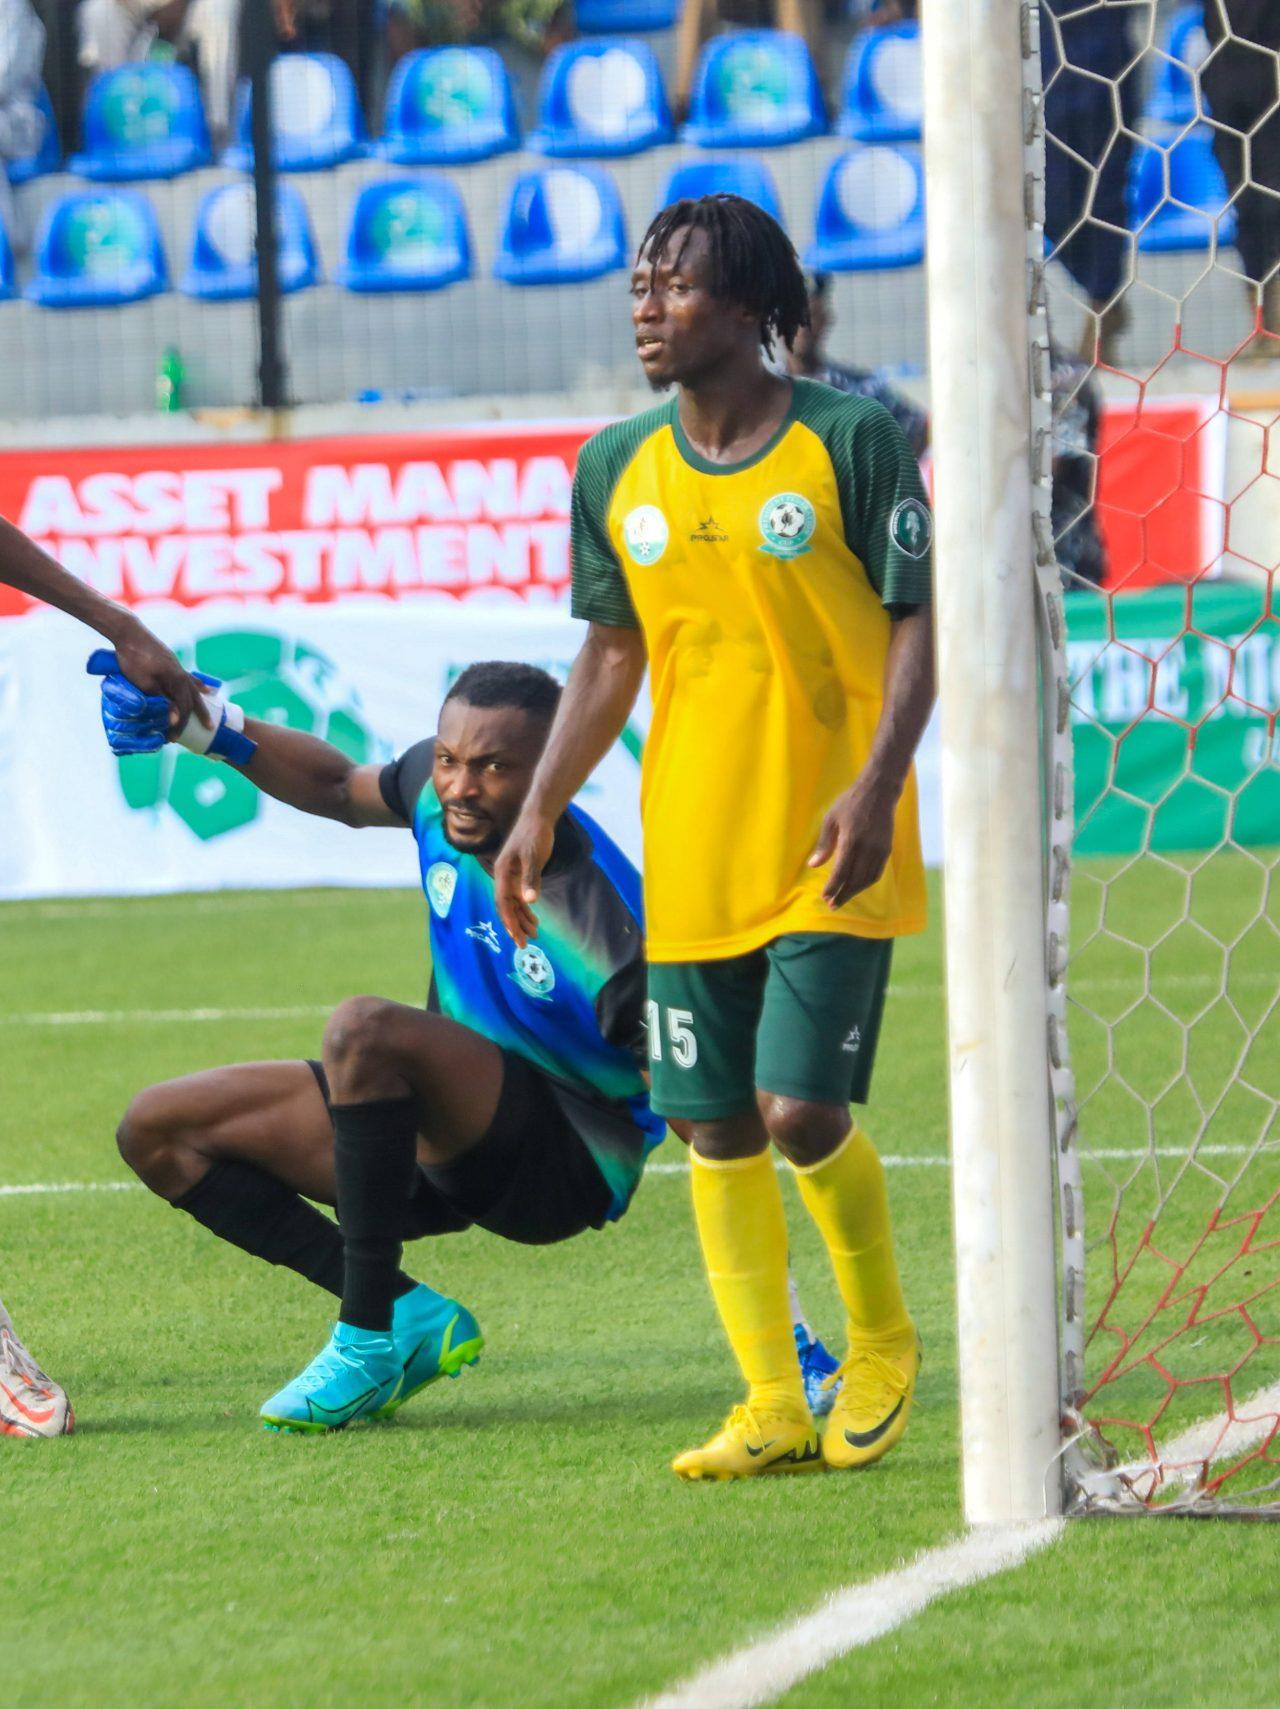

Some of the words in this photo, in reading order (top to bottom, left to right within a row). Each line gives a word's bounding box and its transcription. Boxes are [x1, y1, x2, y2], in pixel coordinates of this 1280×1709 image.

[19, 467, 283, 536] ASSET
[302, 456, 571, 528] MANA
[647, 999, 698, 1069] 15
